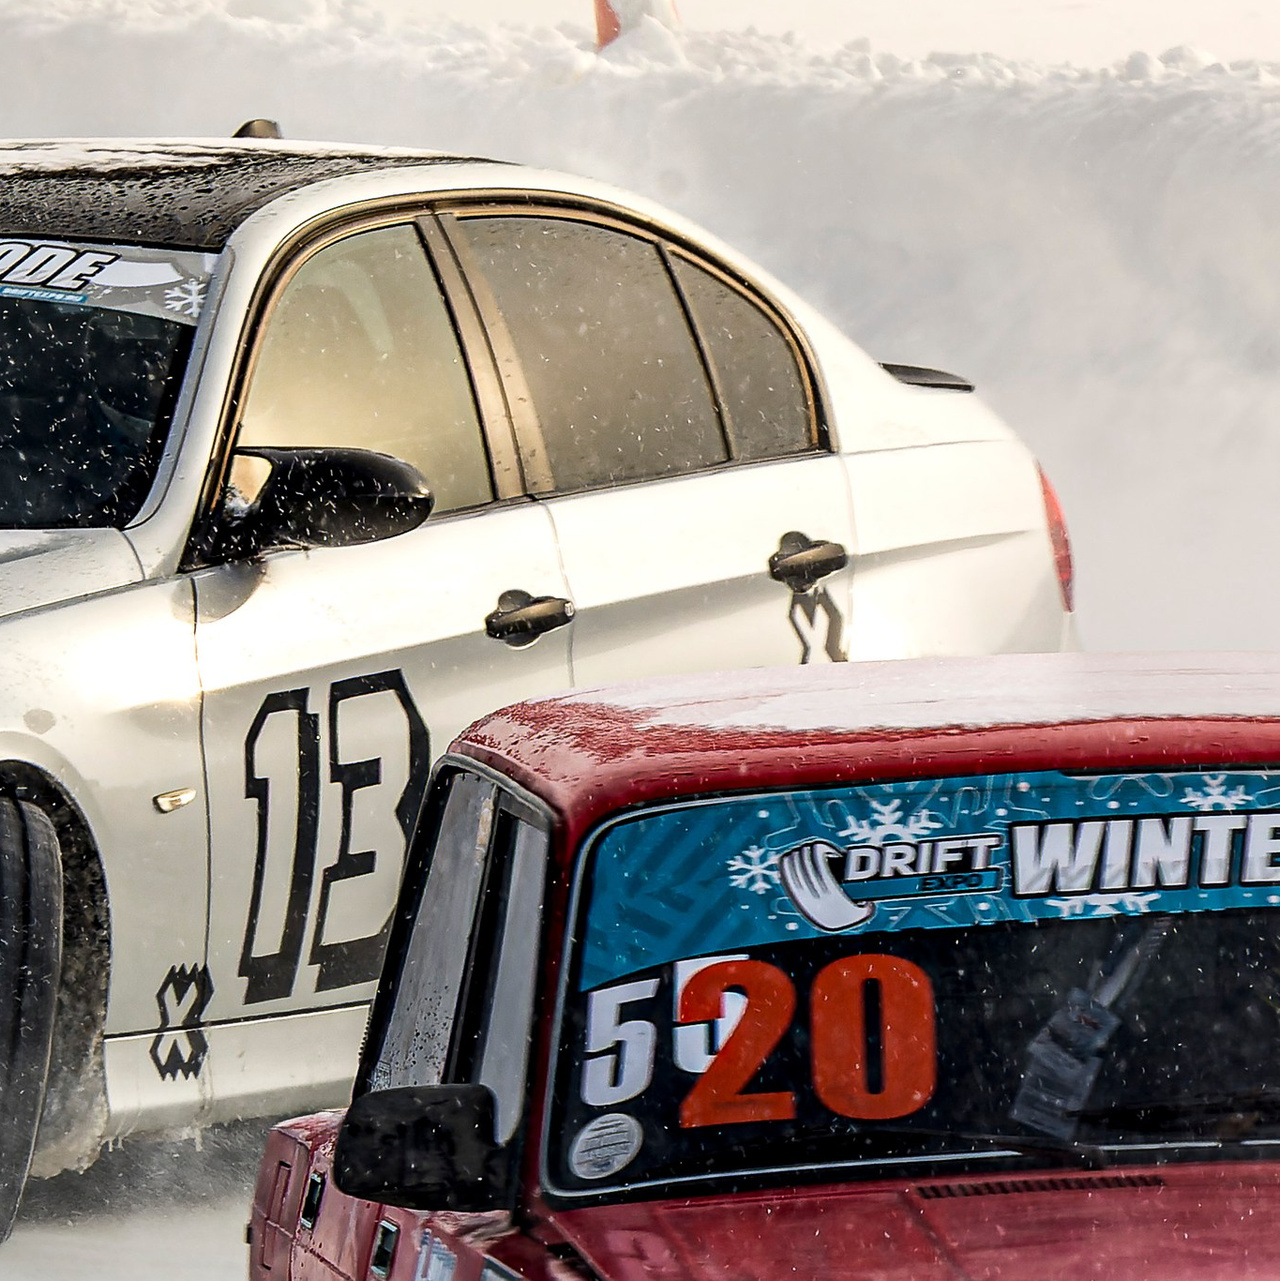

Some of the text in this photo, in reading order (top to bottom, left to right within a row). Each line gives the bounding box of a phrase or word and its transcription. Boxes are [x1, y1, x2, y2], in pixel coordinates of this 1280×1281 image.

[238, 668, 430, 1005] 13
[844, 837, 999, 881] DRIFT
[1012, 814, 1280, 896] WINTE
[921, 872, 984, 892] EXPO
[678, 952, 936, 1129] 20
